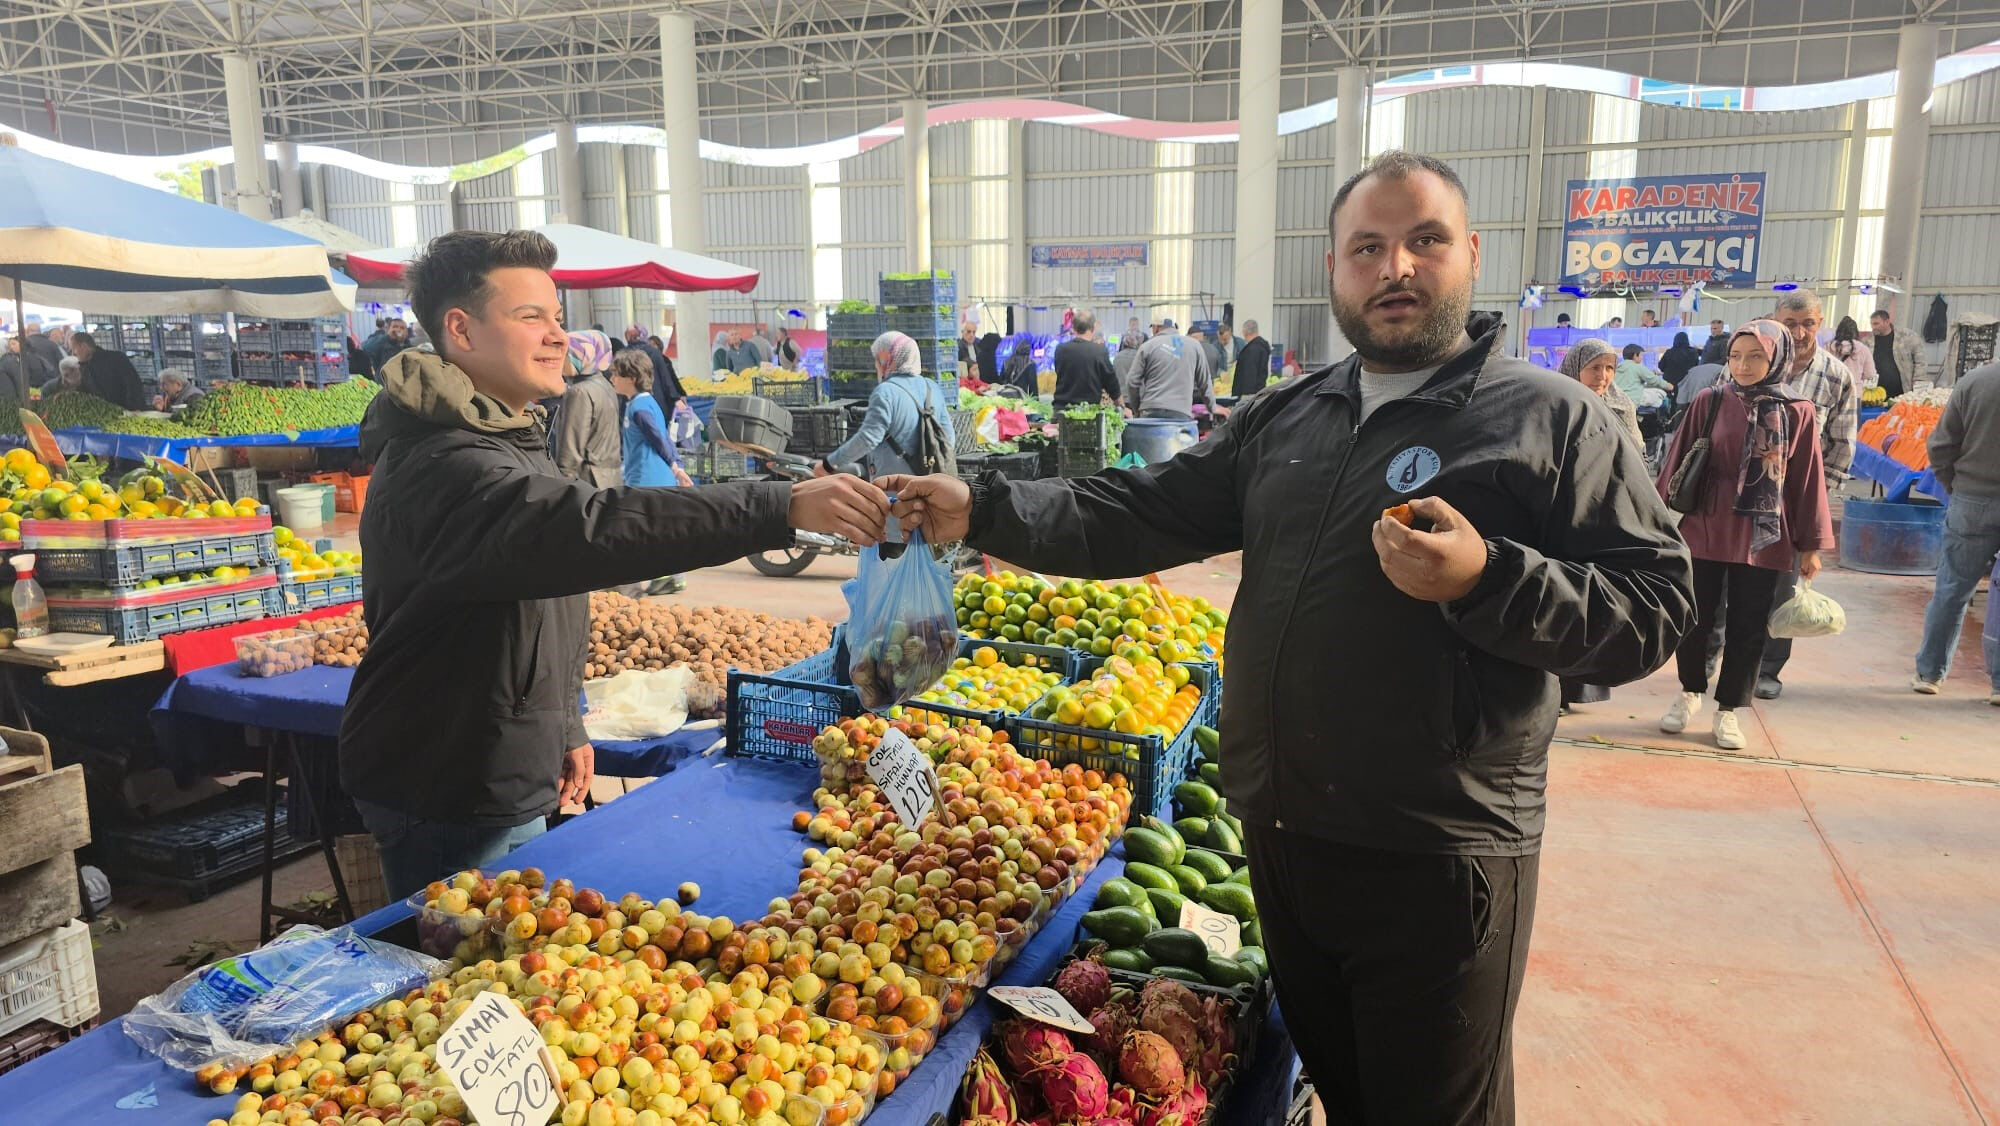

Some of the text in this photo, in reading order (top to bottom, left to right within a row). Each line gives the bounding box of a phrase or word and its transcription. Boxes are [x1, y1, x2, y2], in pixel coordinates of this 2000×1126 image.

[1569, 174, 1761, 222] KARADENİZ
[1604, 209, 1719, 230] BALIKÇILIK
[1566, 233, 1756, 277] BOĞAZİÇİ
[902, 769, 933, 826] 120
[490, 1028, 538, 1078] TATLI
[495, 1063, 548, 1126] 80
